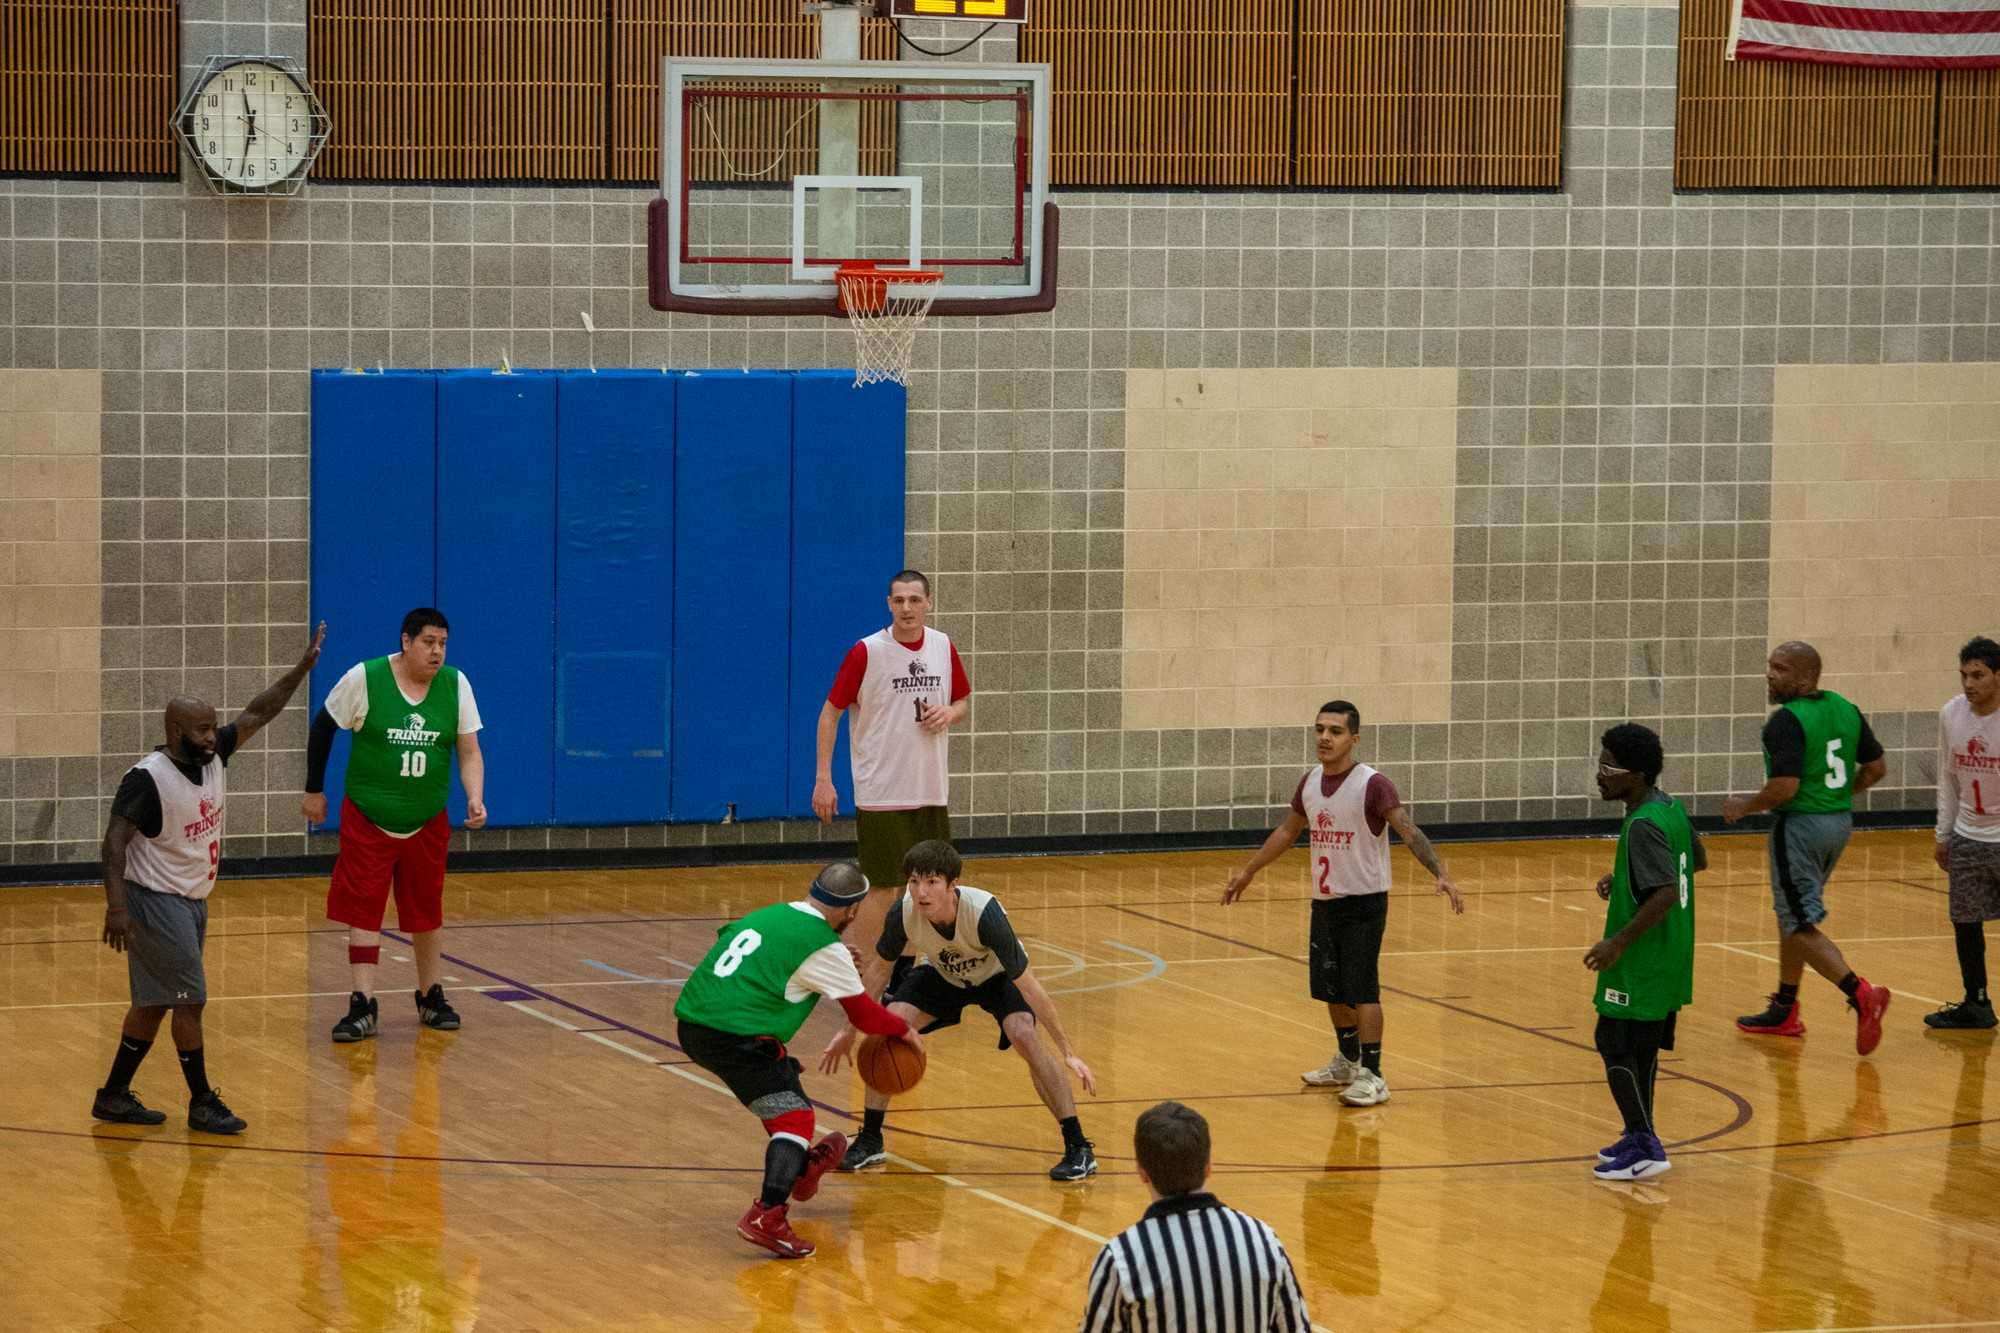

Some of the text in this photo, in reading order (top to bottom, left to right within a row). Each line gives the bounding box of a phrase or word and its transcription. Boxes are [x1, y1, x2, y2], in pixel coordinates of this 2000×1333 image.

[224, 79, 233, 91] 11
[245, 72, 257, 86] 12
[207, 94, 218, 108] 10
[285, 95, 292, 109] 2
[202, 117, 209, 131] 9
[292, 118, 299, 132] 3
[209, 141, 216, 155] 8
[286, 143, 293, 155] 4
[225, 158, 233, 171] 7
[248, 164, 255, 177] 6
[270, 158, 277, 171] 5
[892, 675, 942, 689] TRINITY
[386, 727, 441, 742] TRINITY
[400, 750, 427, 777] 10
[1825, 738, 1847, 789] 5
[1972, 779, 1985, 815] 1
[1318, 856, 1330, 894] 2
[713, 928, 762, 978] 8
